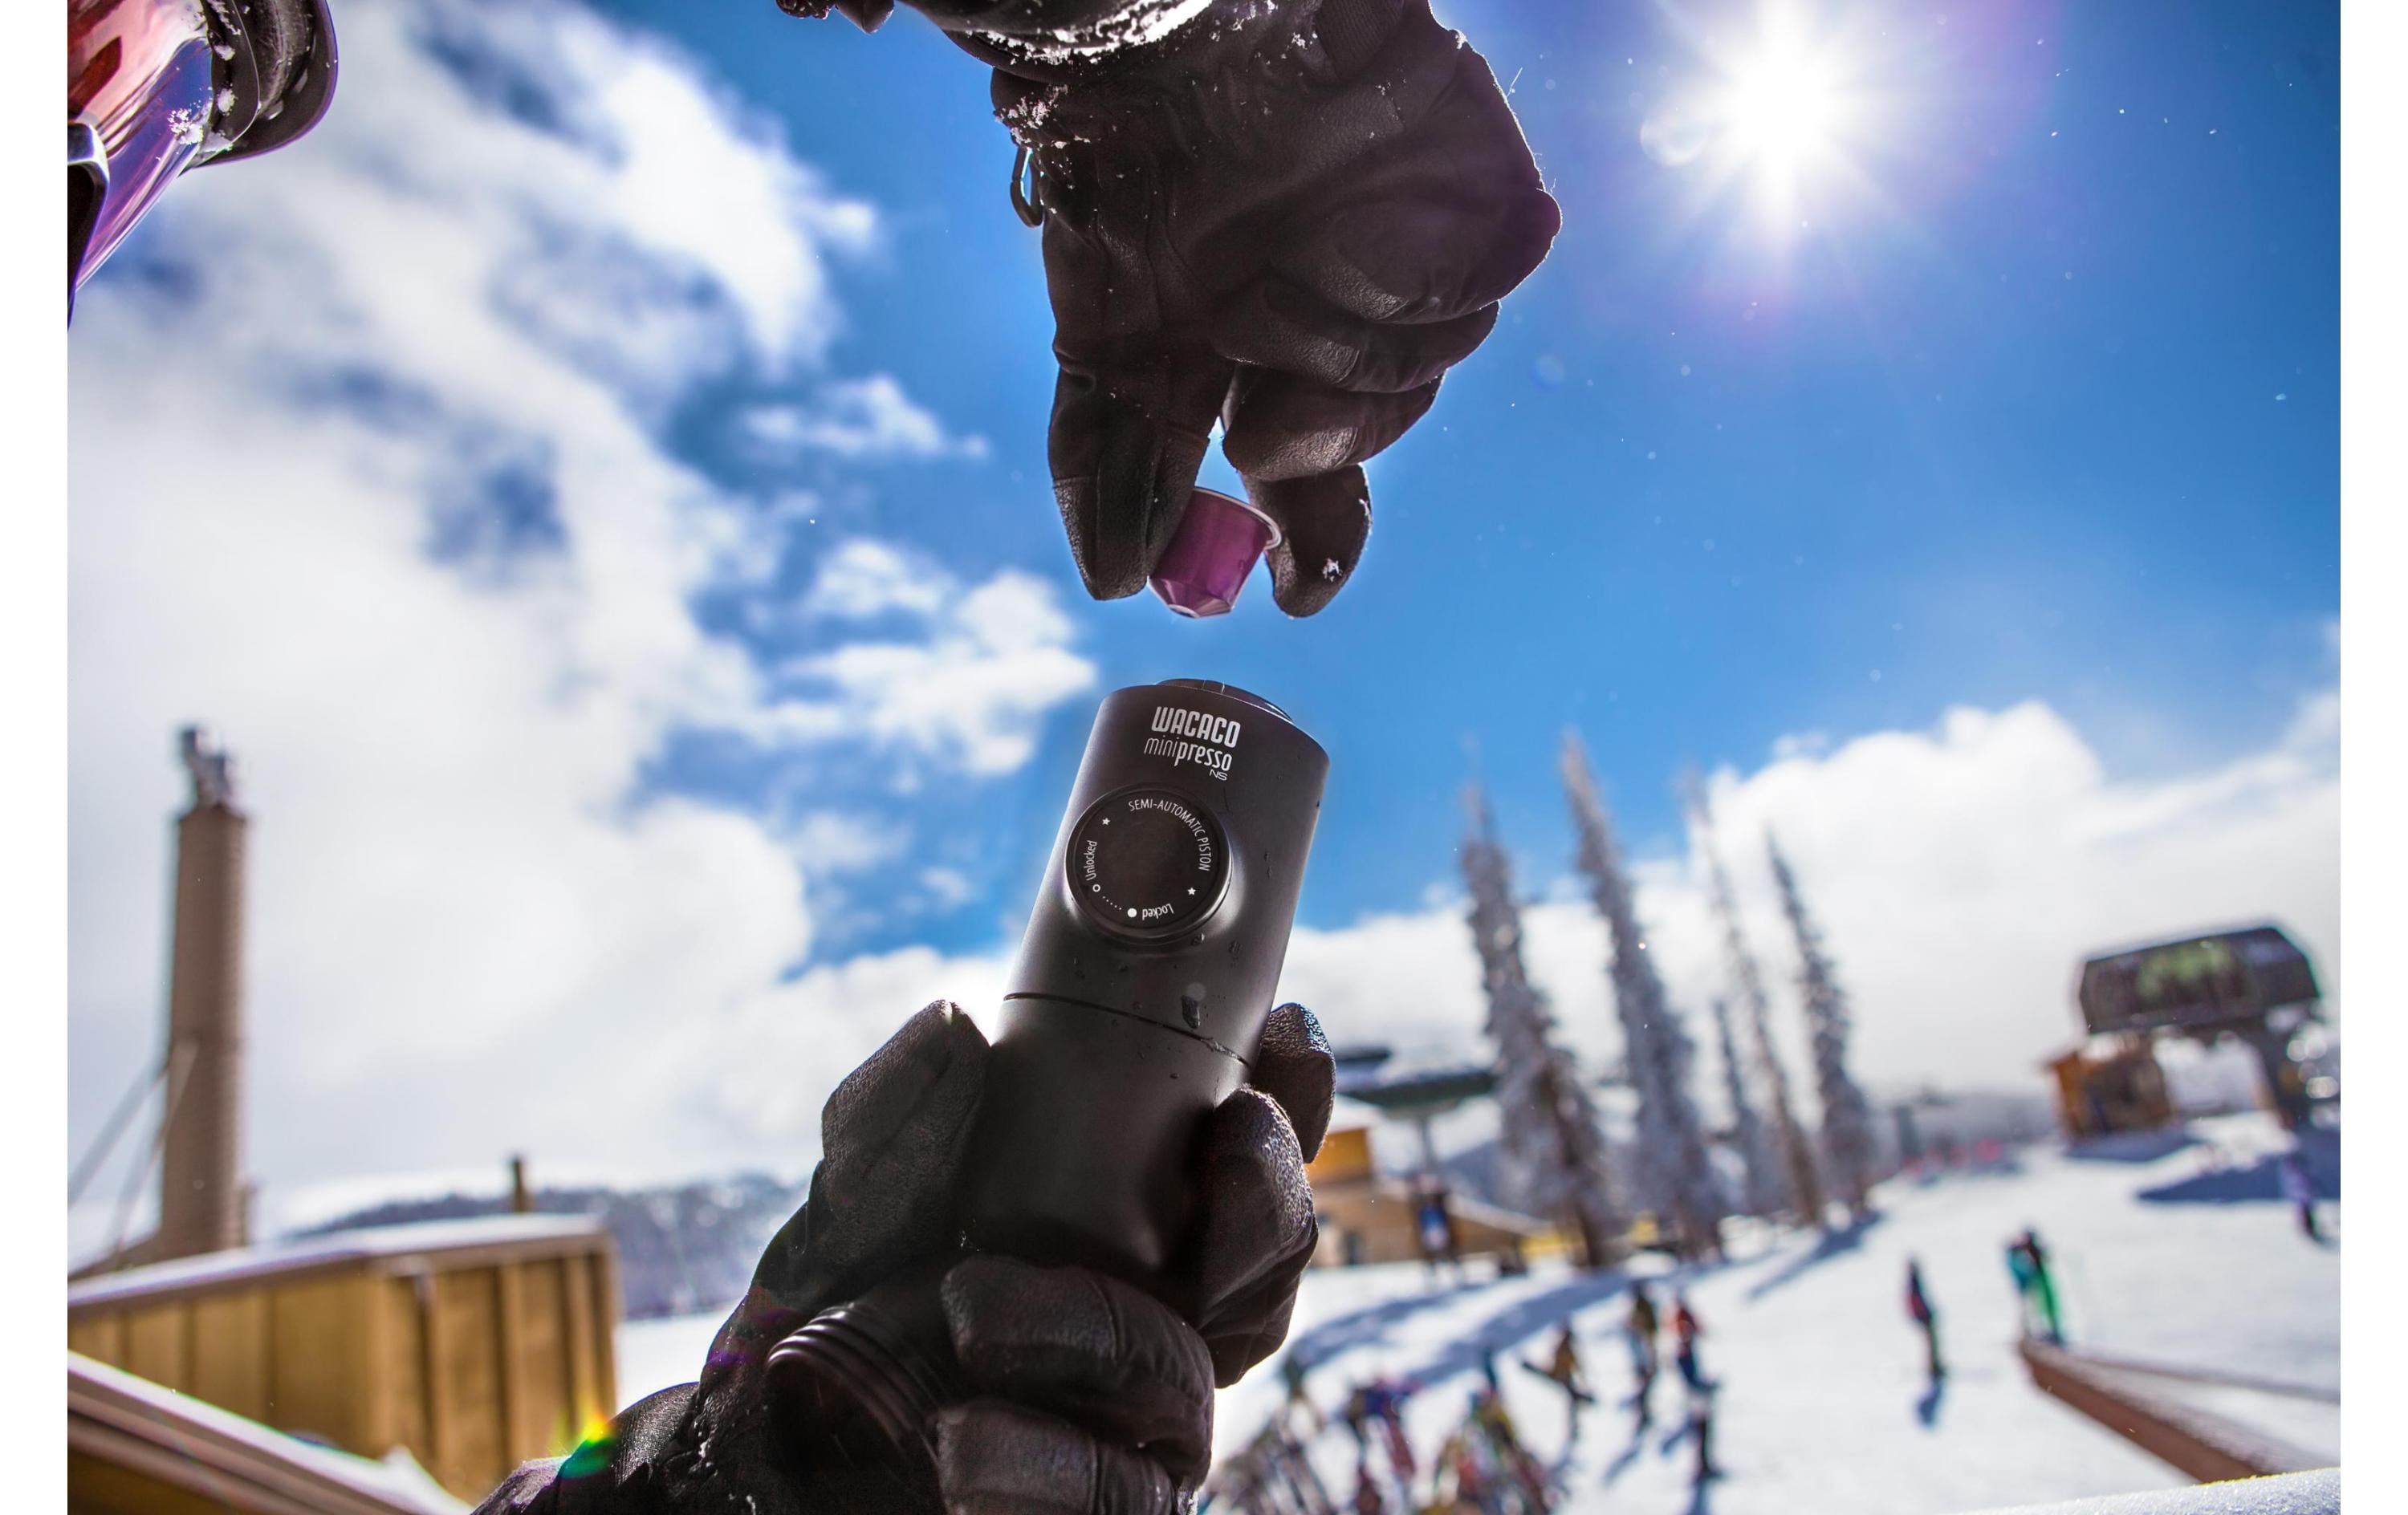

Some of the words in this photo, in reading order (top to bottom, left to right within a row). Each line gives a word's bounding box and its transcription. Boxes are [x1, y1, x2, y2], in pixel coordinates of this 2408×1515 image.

[1151, 706, 1241, 748] WACACO
[1144, 735, 1232, 771] minipresso
[1209, 769, 1228, 782] NS
[1128, 798, 1205, 837] SEMI-AUTOMATIC
[1197, 837, 1211, 872] PISTON
[1084, 839, 1097, 881] Unlocked
[1141, 903, 1174, 921] Locked
